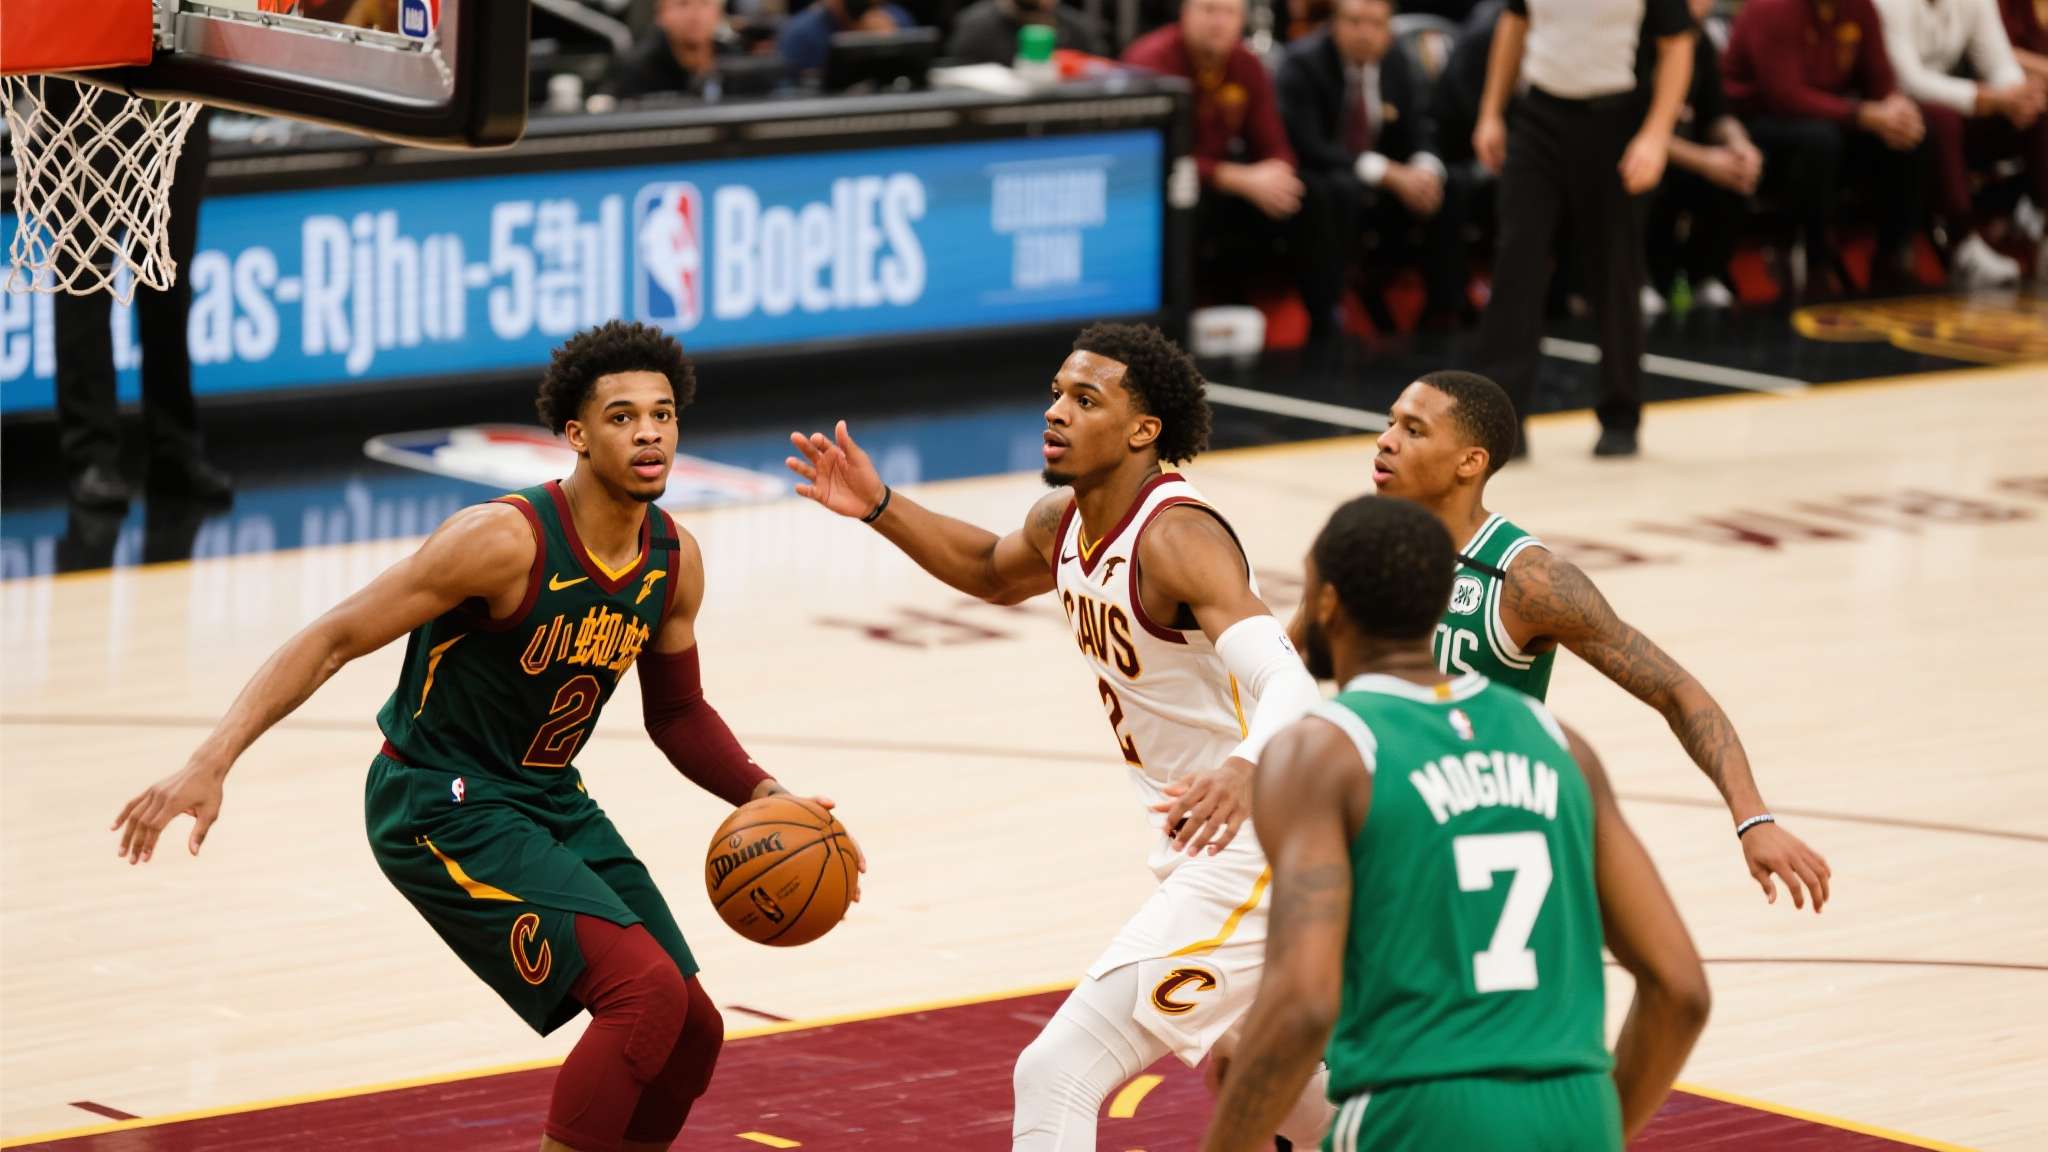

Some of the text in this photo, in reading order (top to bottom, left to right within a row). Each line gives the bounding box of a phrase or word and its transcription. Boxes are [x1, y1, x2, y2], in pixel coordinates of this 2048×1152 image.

[522, 675, 600, 767] 2
[511, 913, 551, 984] C
[1453, 831, 1553, 993] 7
